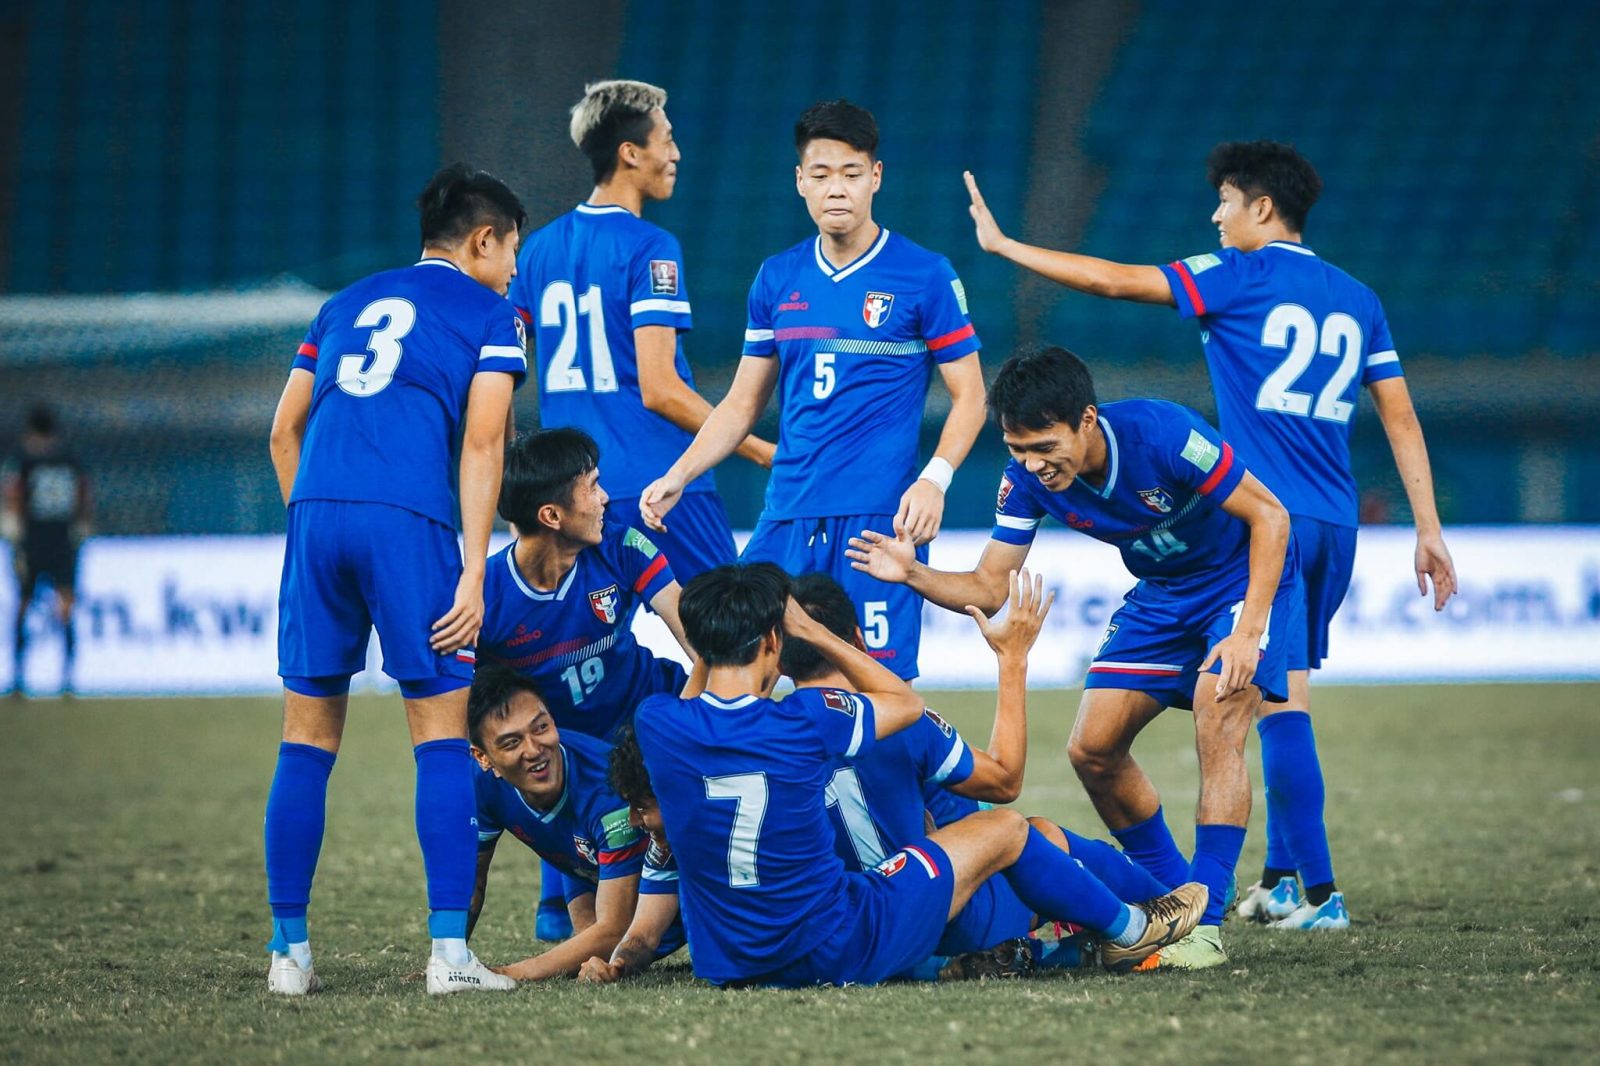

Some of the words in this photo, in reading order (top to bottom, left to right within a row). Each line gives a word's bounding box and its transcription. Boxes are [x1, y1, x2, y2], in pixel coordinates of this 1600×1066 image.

[336, 297, 417, 398] 3
[540, 280, 619, 393] 21
[812, 353, 836, 400] 5
[1256, 302, 1364, 425] 22
[1131, 528, 1188, 562] 14
[864, 601, 889, 649] 5
[560, 656, 605, 706] 19
[703, 771, 769, 888] 7
[448, 975, 481, 985] ATHLETA
